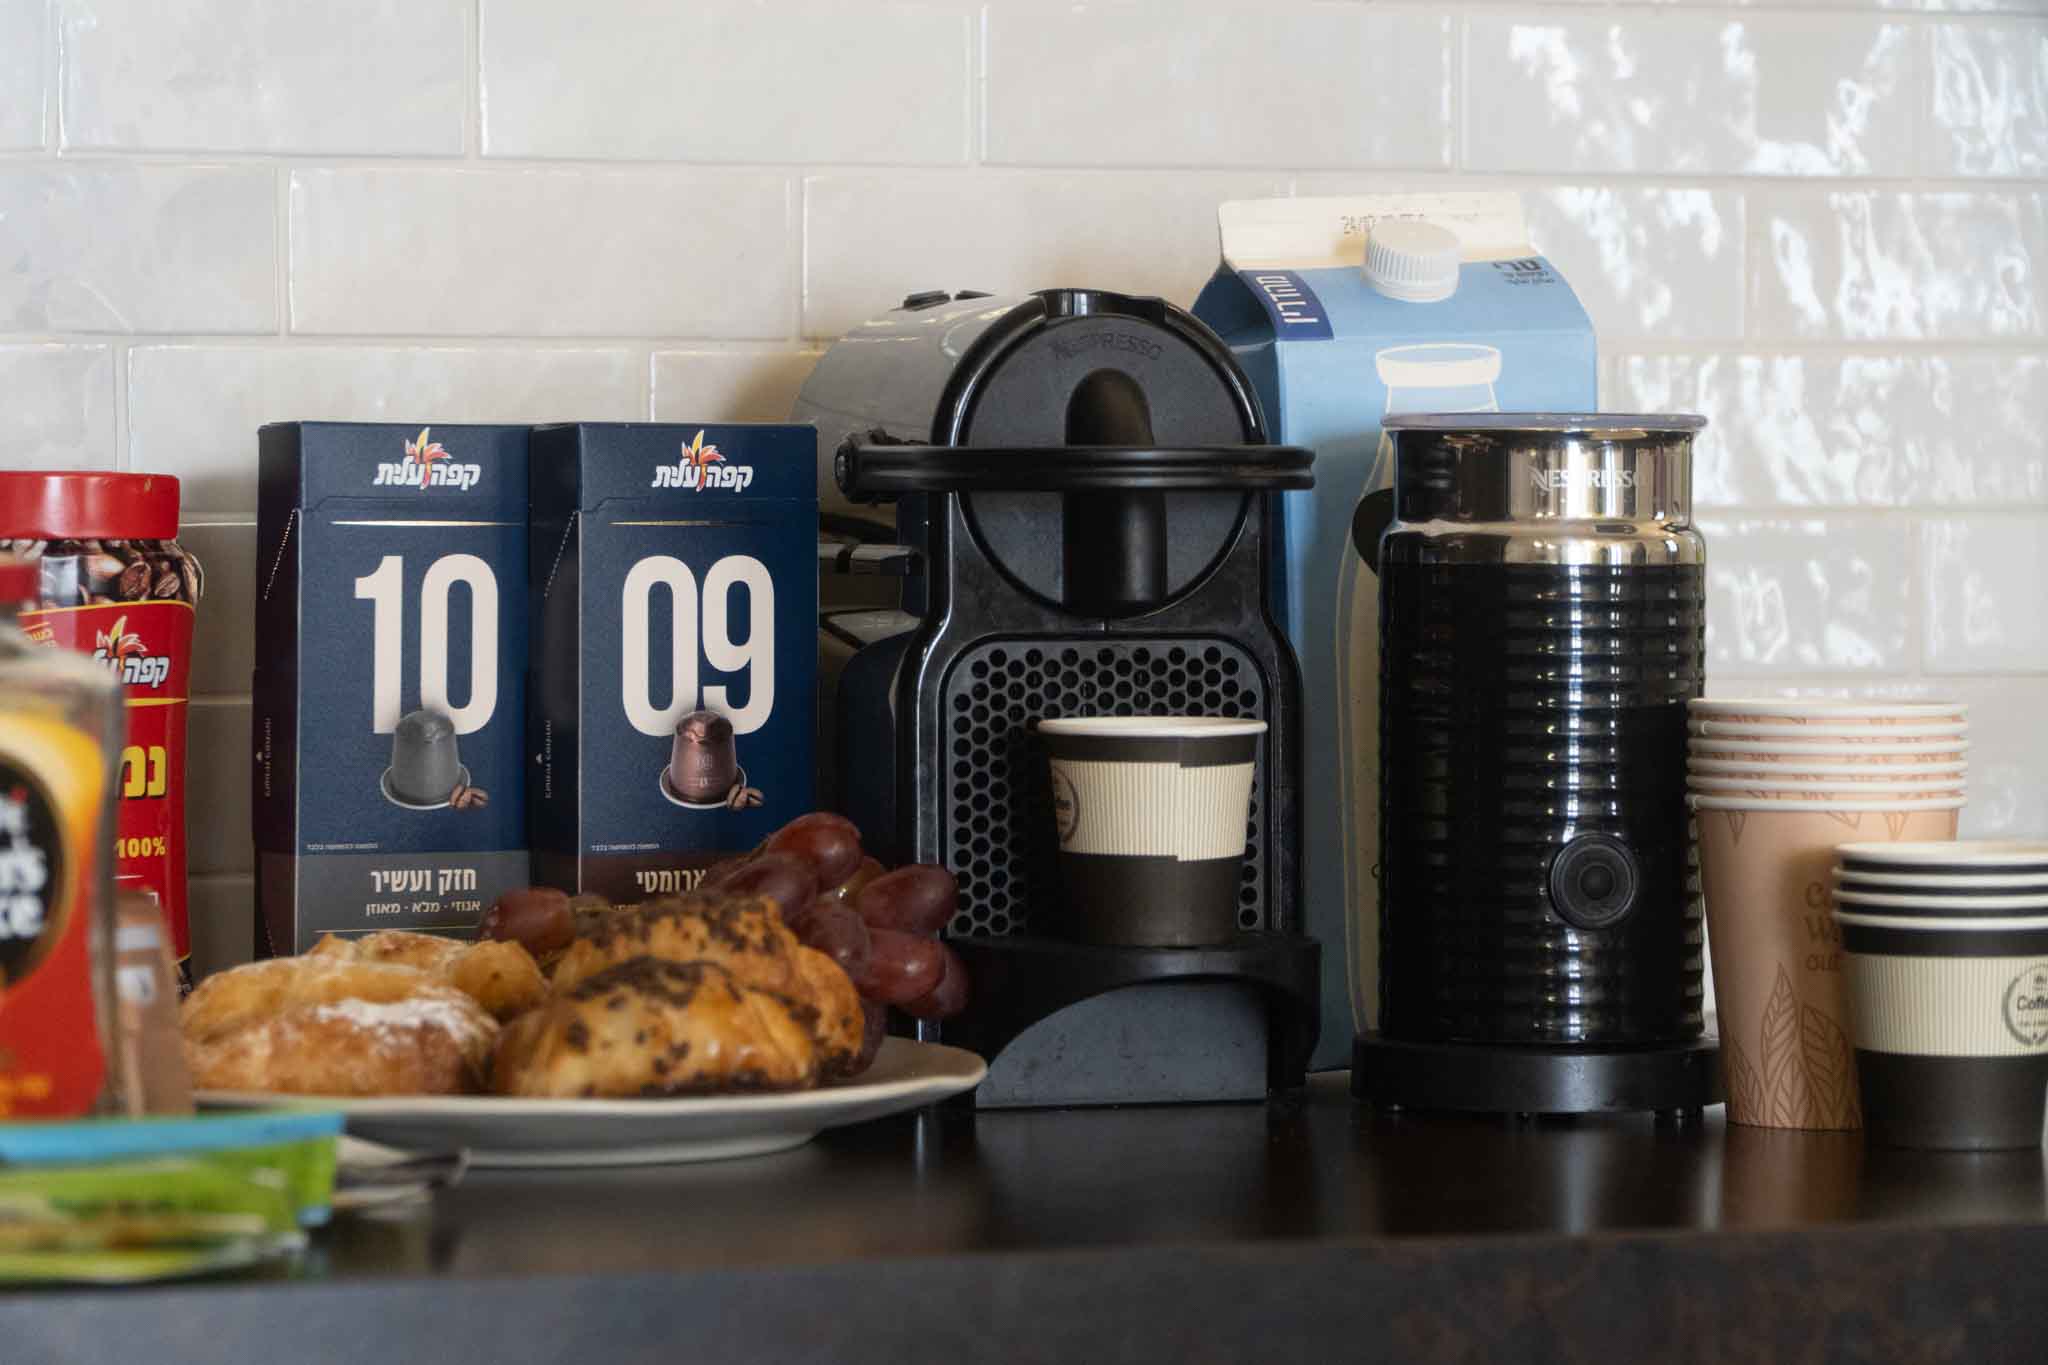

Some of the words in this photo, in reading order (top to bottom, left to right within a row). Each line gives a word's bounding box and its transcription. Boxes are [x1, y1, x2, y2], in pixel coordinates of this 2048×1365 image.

[1255, 275, 1319, 323] מהדרין
[373, 455, 427, 487] עלית
[430, 463, 481, 491] קפה
[651, 457, 701, 488] עלית
[705, 465, 754, 493] קפה
[354, 553, 499, 735] 10
[621, 554, 775, 737] 09
[122, 656, 170, 688] קפה
[114, 836, 167, 858] 100%
[369, 870, 432, 894] ועשיר
[438, 868, 477, 896] חזק
[635, 869, 707, 893] ארומטי
[365, 903, 401, 917] מאוזן
